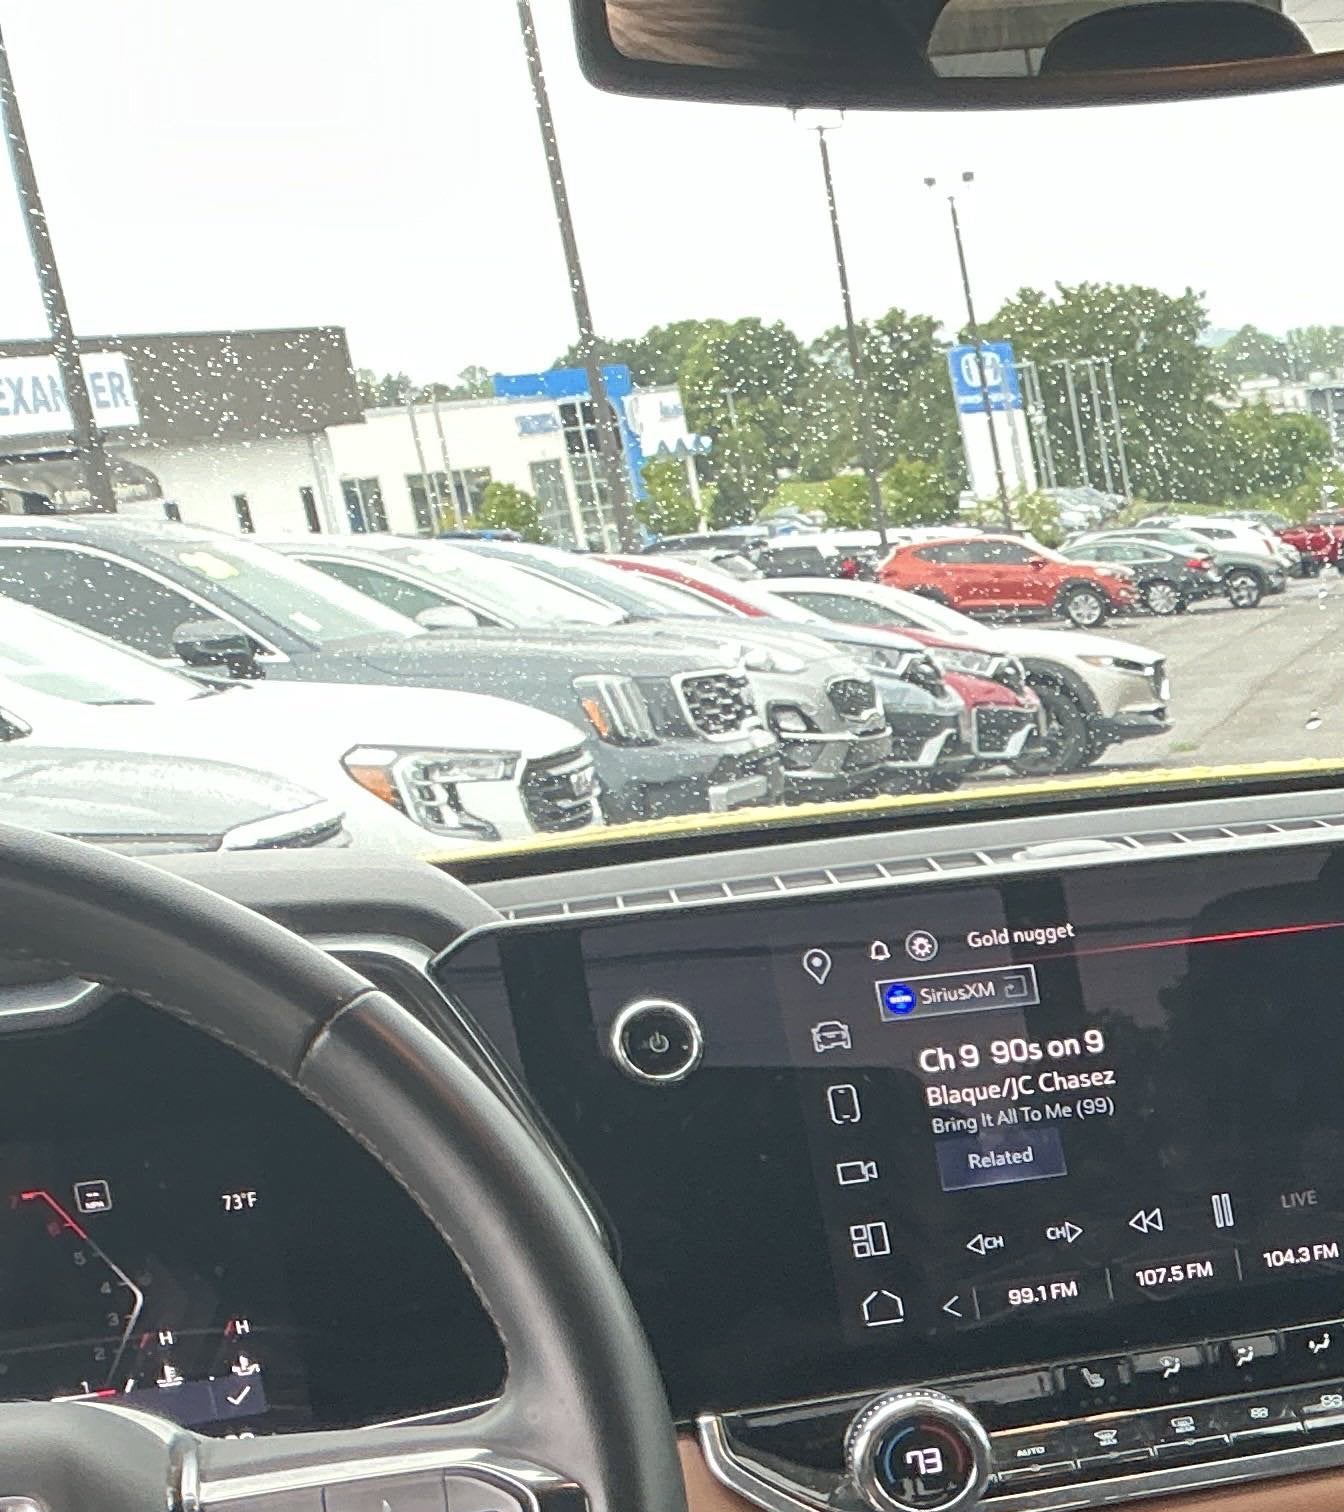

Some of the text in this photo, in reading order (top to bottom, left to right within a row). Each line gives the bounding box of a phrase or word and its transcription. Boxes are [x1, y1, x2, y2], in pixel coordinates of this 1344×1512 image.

[967, 922, 1075, 949] Gold nugget
[920, 981, 996, 1005] SiriusXM
[919, 1029, 1105, 1072] Ch 9 90s on 9
[926, 1069, 1117, 1107] Blaque/JC Chasez
[931, 1096, 1115, 1134] Bring It All To Me (99)
[967, 1146, 1034, 1170] Related
[1280, 1190, 1318, 1208] LIVE
[1263, 1242, 1339, 1268] 104.3 FM
[1135, 1261, 1214, 1287] 107.5 FM
[1008, 1280, 1078, 1305] 99.1 FM
[905, 1447, 942, 1475] 73
[1016, 1446, 1046, 1457] AUTO
